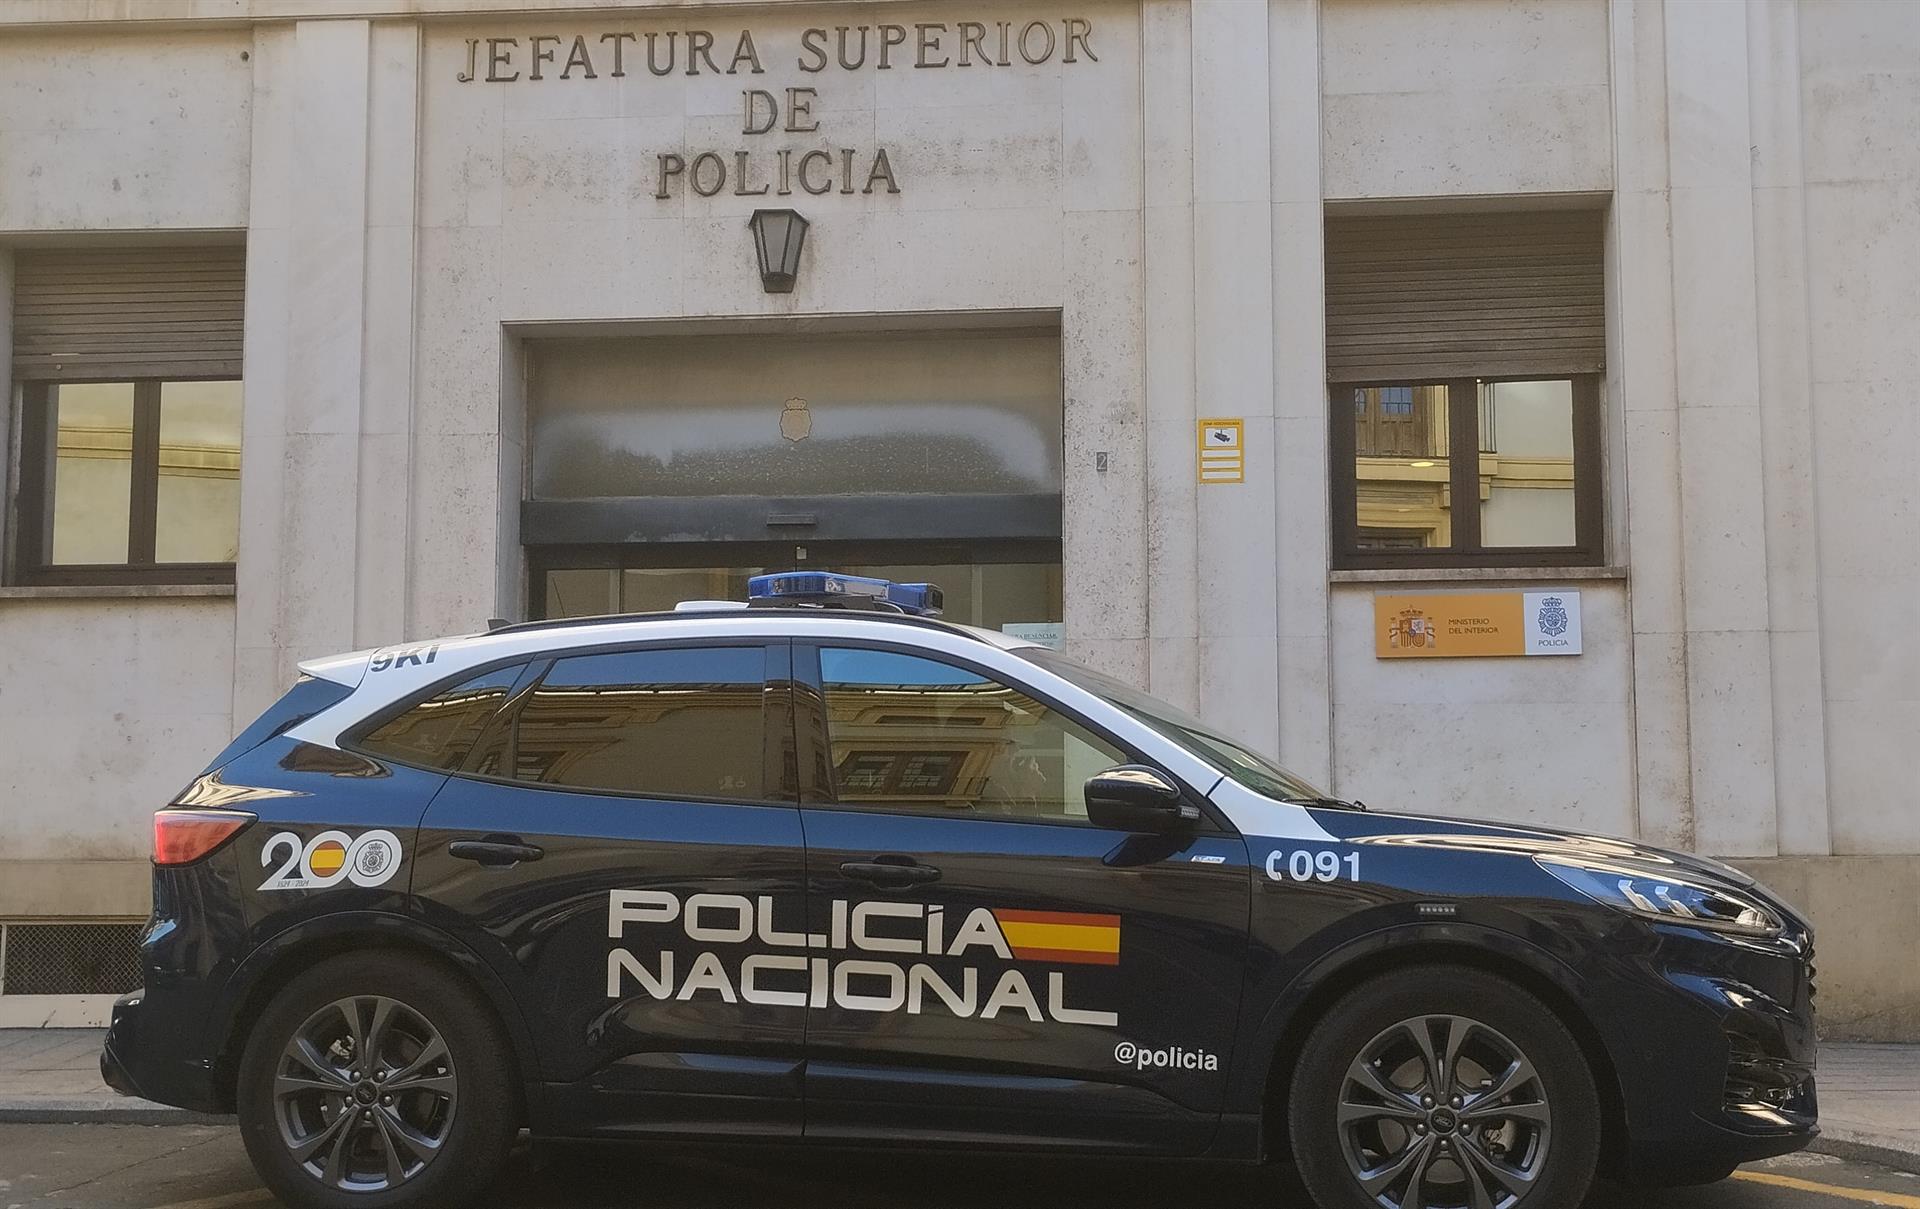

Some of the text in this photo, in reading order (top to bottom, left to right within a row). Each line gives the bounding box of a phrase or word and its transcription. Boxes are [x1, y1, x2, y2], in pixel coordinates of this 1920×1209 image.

[457, 17, 1100, 83] JEFATURA SUPERIOR
[742, 87, 820, 135] DE
[655, 147, 901, 200] POLICIA
[1448, 617, 1491, 626] MINISTERIO
[1448, 626, 1499, 635] DEL INTERIOR
[256, 829, 403, 891] 200
[1288, 850, 1361, 883] 091
[607, 948, 1119, 1027] NACIONAL
[1114, 1041, 1218, 1071] @policia
